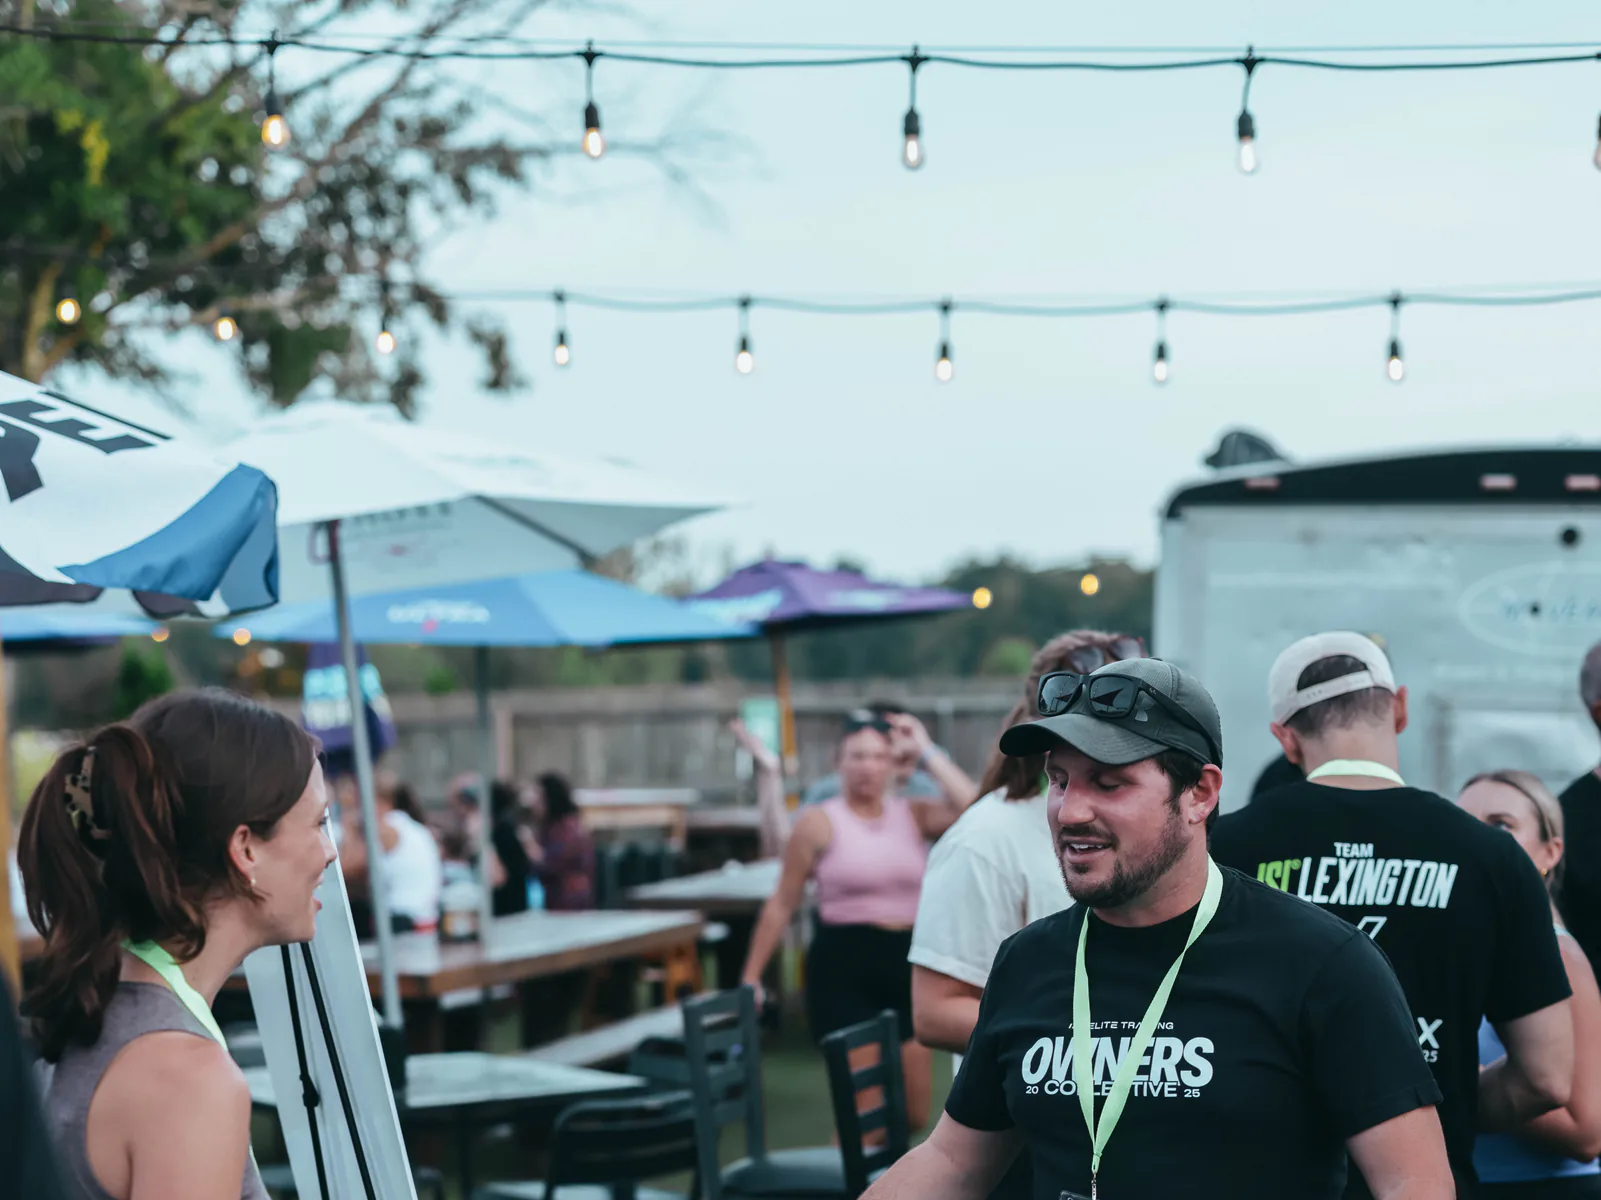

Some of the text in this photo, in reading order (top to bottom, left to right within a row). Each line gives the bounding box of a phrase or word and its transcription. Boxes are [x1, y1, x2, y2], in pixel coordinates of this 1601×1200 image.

[1333, 842, 1374, 858] TEAM
[1297, 856, 1459, 909] LEXINGTON
[1021, 1036, 1215, 1088] OWNERS
[1025, 1085, 1039, 1095] 20
[1184, 1088, 1201, 1098] 25
